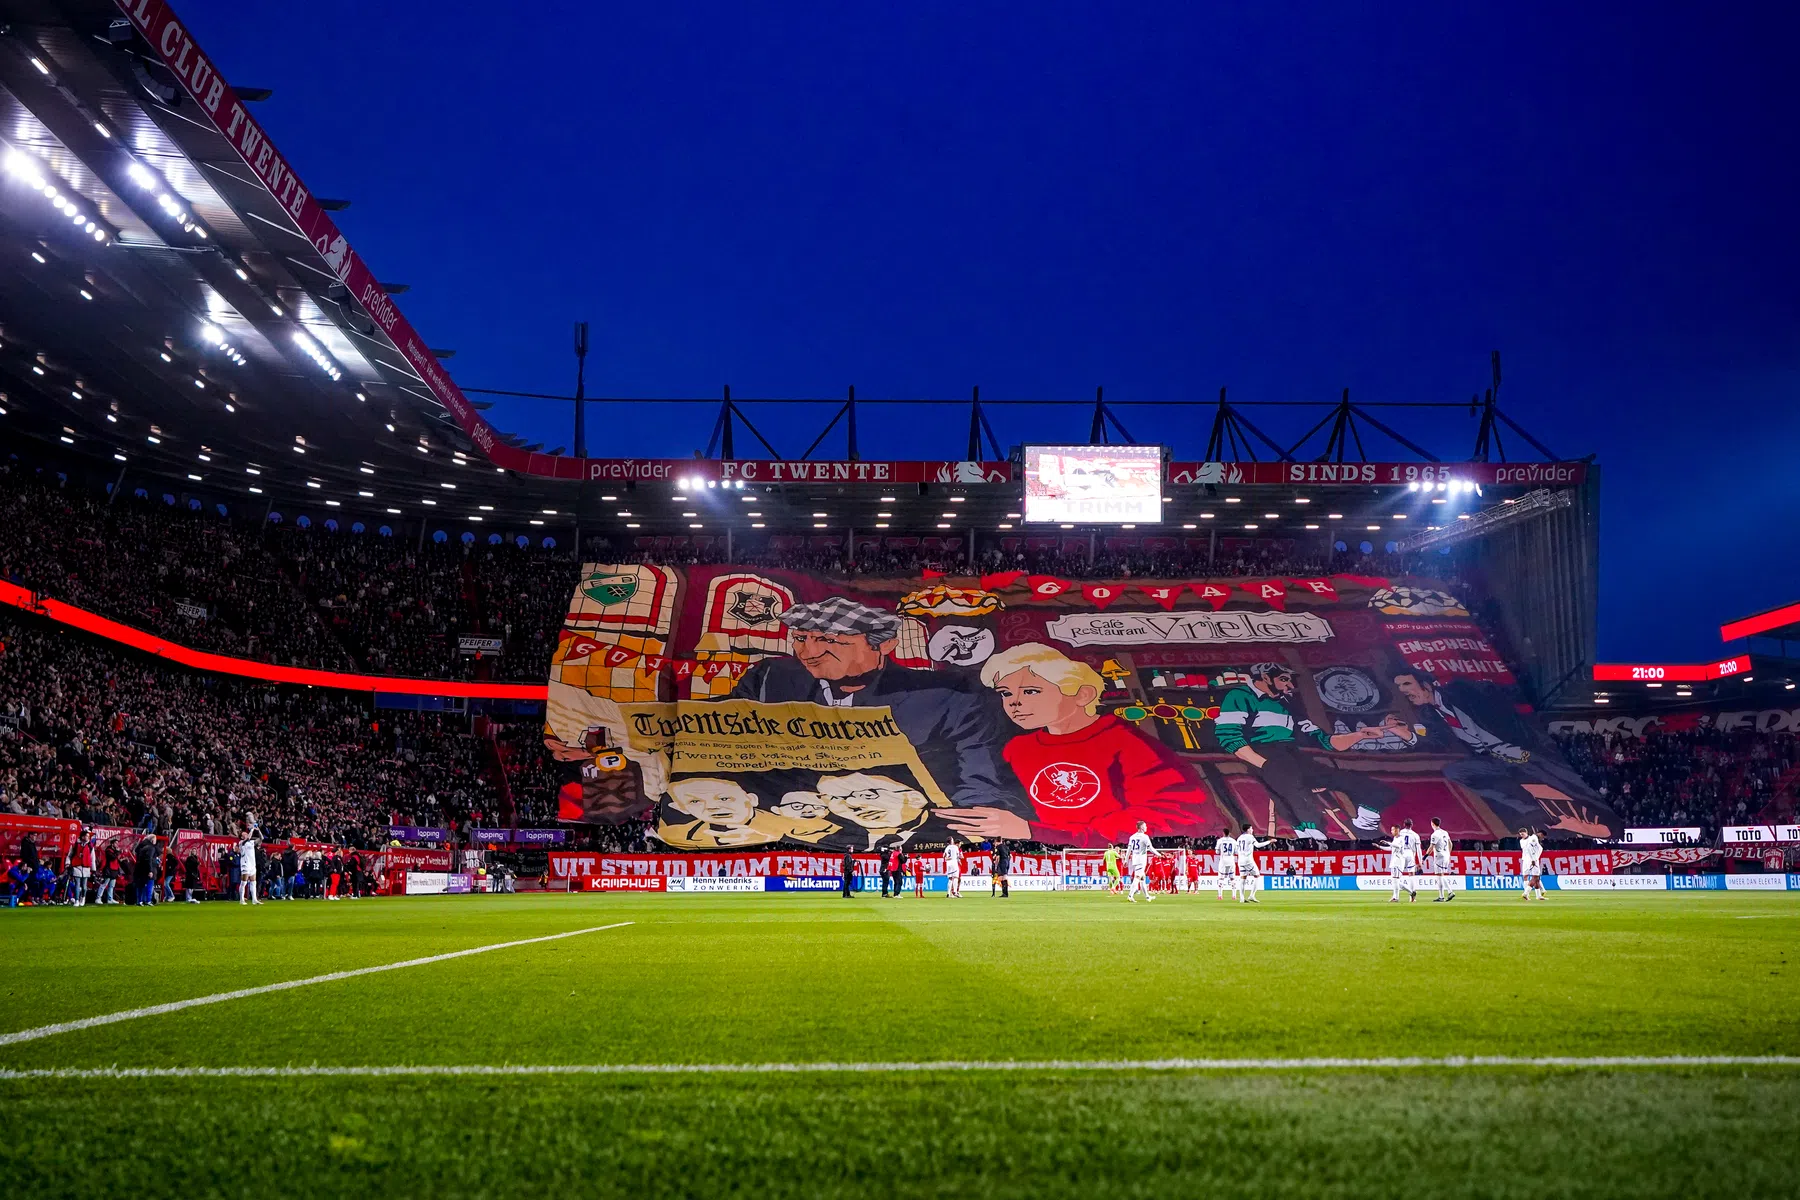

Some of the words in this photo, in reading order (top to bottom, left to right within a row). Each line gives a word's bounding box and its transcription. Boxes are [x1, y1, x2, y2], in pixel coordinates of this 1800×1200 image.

[161, 21, 225, 114] CLUB
[227, 102, 308, 220] TWENTE
[361, 283, 398, 332] previder
[472, 423, 495, 454] previder
[591, 460, 672, 480] previder
[722, 462, 757, 479] FC
[770, 462, 889, 480] TWENTE
[1290, 464, 1377, 482] SINDS
[1390, 465, 1450, 482] 1965
[1496, 463, 1576, 483] previder
[1063, 500, 1143, 514] TRIMM
[1090, 618, 1124, 630] Café
[1131, 614, 1314, 640] Vrieler
[1071, 626, 1148, 638] Restaurant
[460, 639, 493, 647] PFEIFER
[1399, 638, 1491, 655] ENSCHEDE
[1434, 658, 1508, 674] TWENTE
[1719, 661, 1737, 675] 21:00
[1632, 667, 1665, 679] 21:00
[630, 709, 784, 738] Twentsche
[787, 711, 902, 741] Courant
[674, 750, 732, 760] Twente
[868, 751, 882, 759] in
[1659, 832, 1687, 843] TOTO
[1735, 829, 1762, 841] TOTO
[924, 842, 946, 850] APRIL
[553, 857, 595, 877] UIT
[601, 858, 688, 878] STRIJD
[693, 856, 771, 877] KWAM
[776, 856, 883, 877] EENHID
[1258, 855, 1337, 876] LEEFT
[1464, 855, 1514, 876] ENE
[1519, 853, 1610, 876] ACHT!
[591, 878, 660, 889] KAMPHUIS
[692, 877, 717, 885] Henny
[718, 877, 752, 885] Hendriks
[784, 878, 840, 891] wildkamp
[963, 879, 987, 887] MEER
[1014, 879, 1053, 887] ELEKTRA
[1271, 877, 1341, 889] ELEKTRAMAT
[1673, 876, 1718, 889] ELEKTRAMAT
